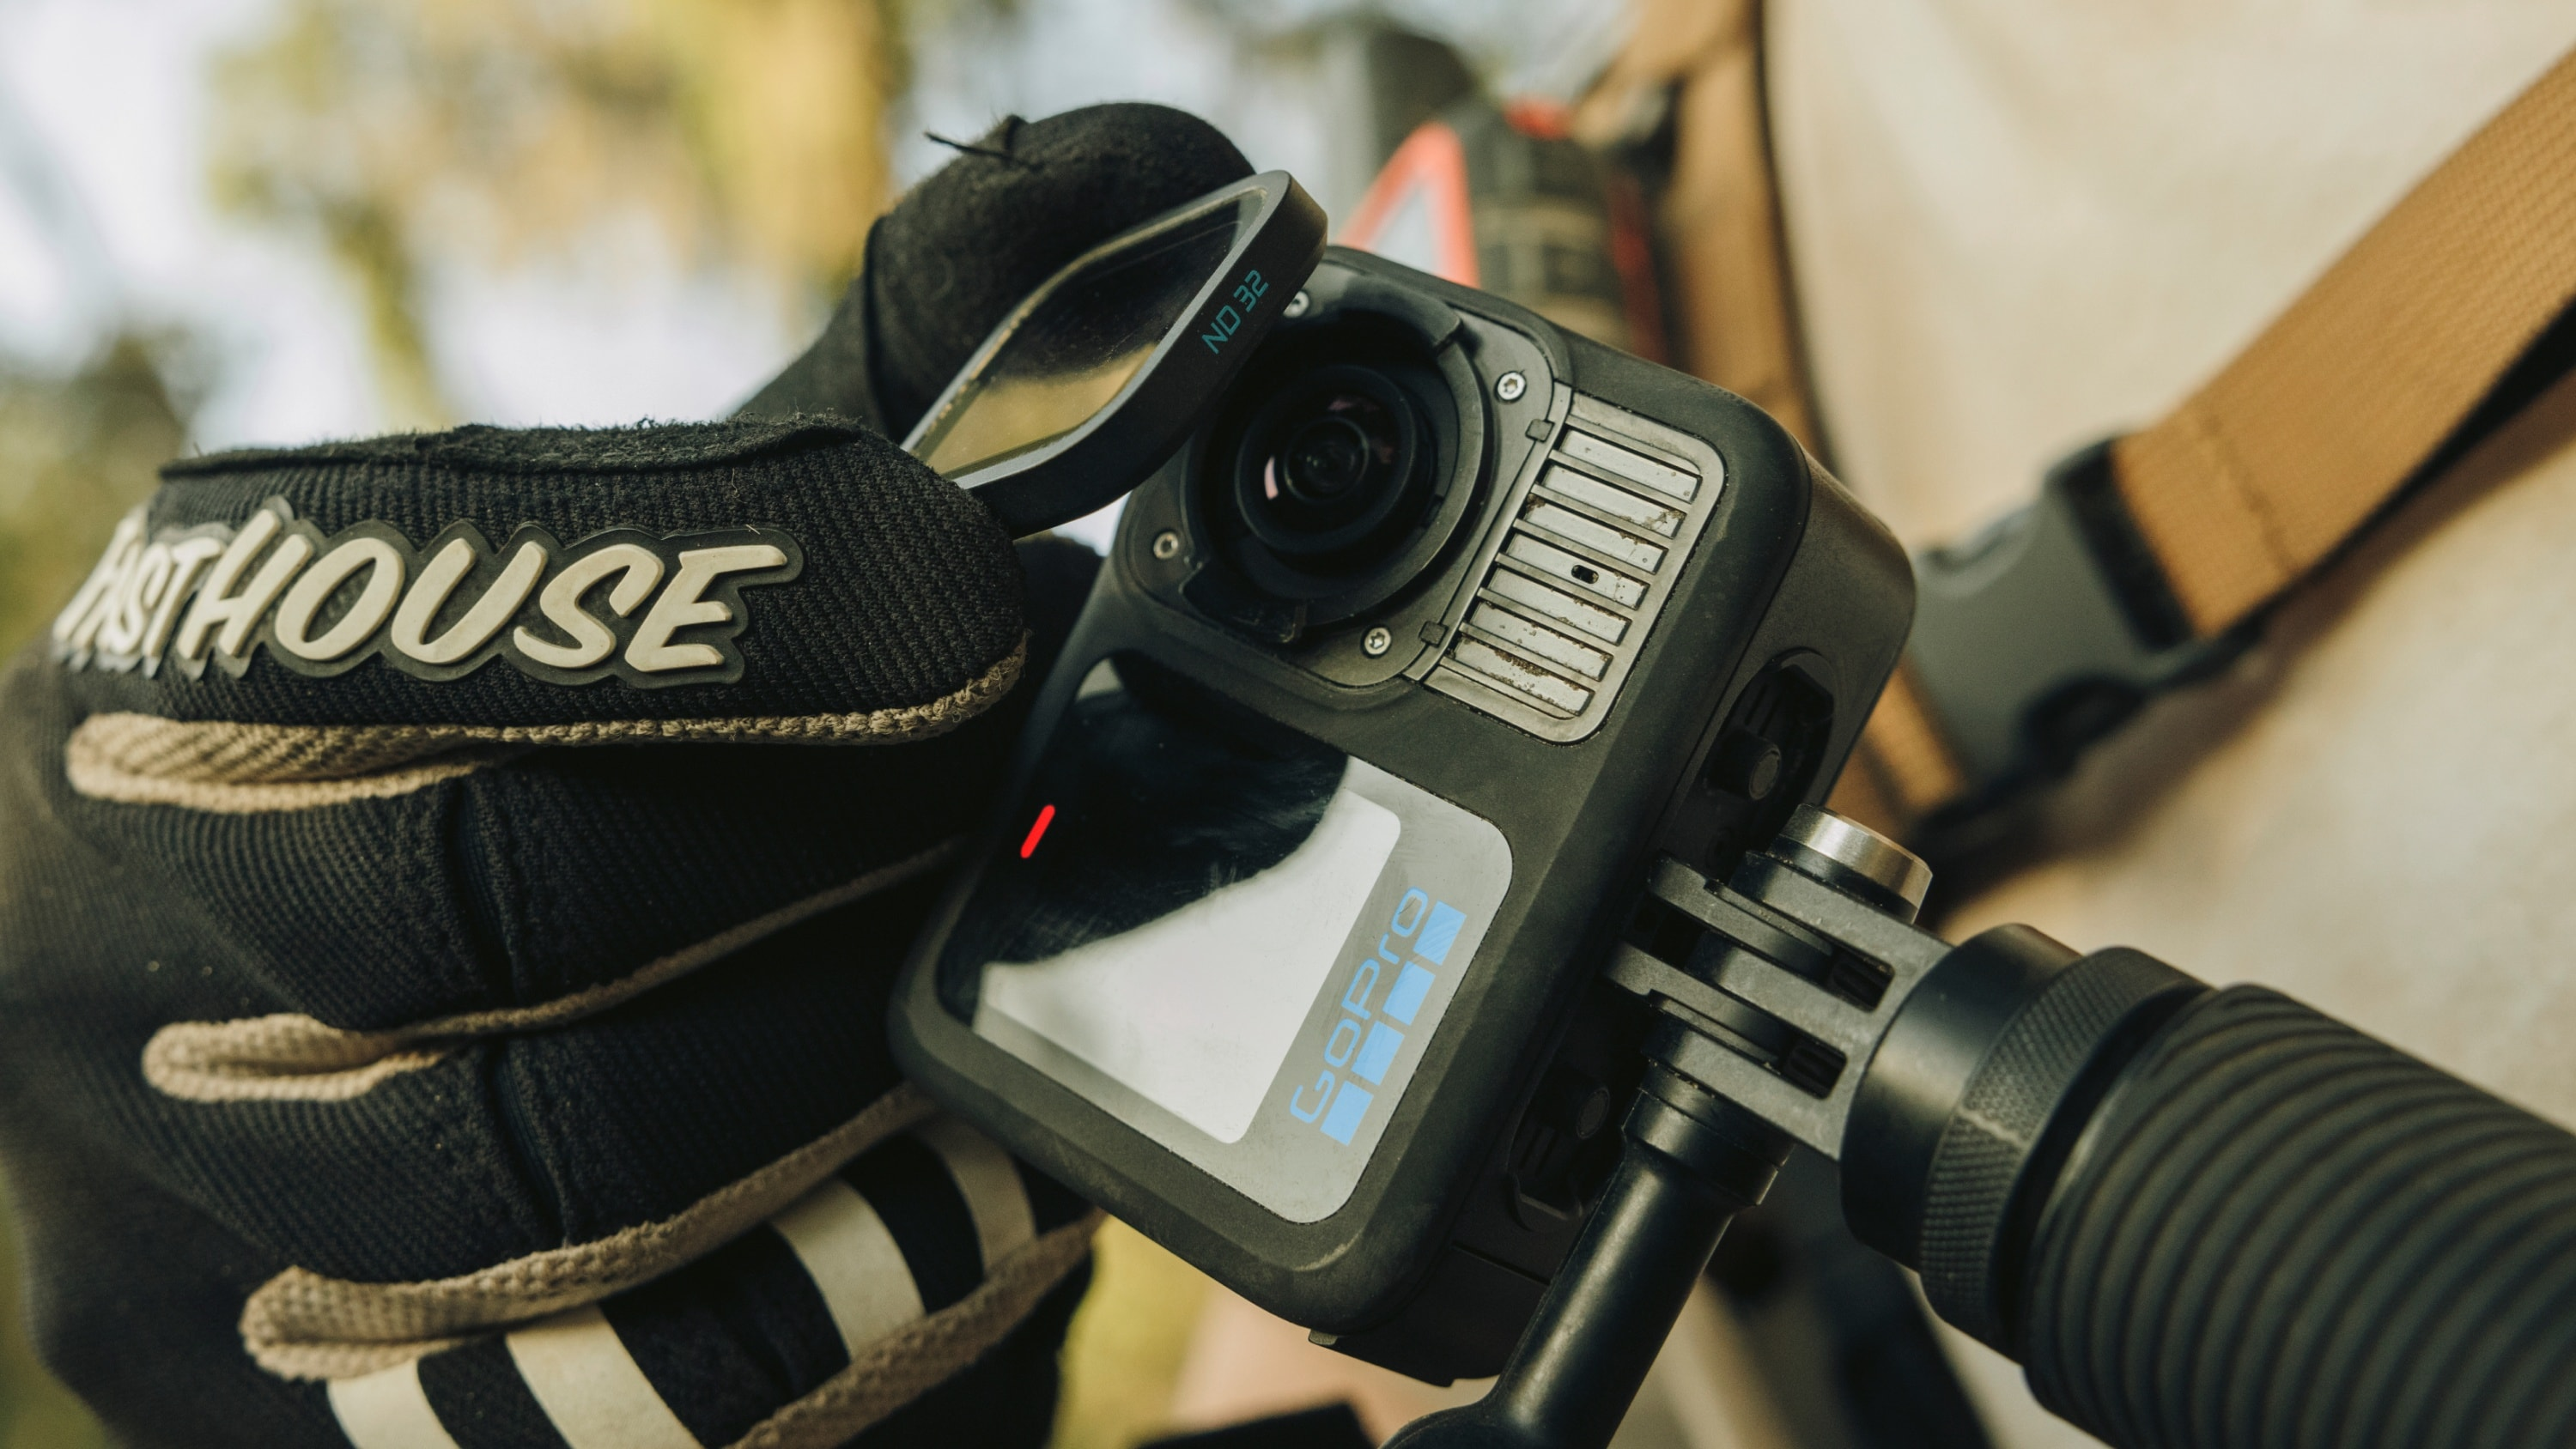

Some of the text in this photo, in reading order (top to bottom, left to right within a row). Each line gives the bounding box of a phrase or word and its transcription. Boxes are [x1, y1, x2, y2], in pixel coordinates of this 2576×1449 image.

[1202, 270, 1269, 354] ND 32
[1290, 886, 1429, 1124] GoPro
